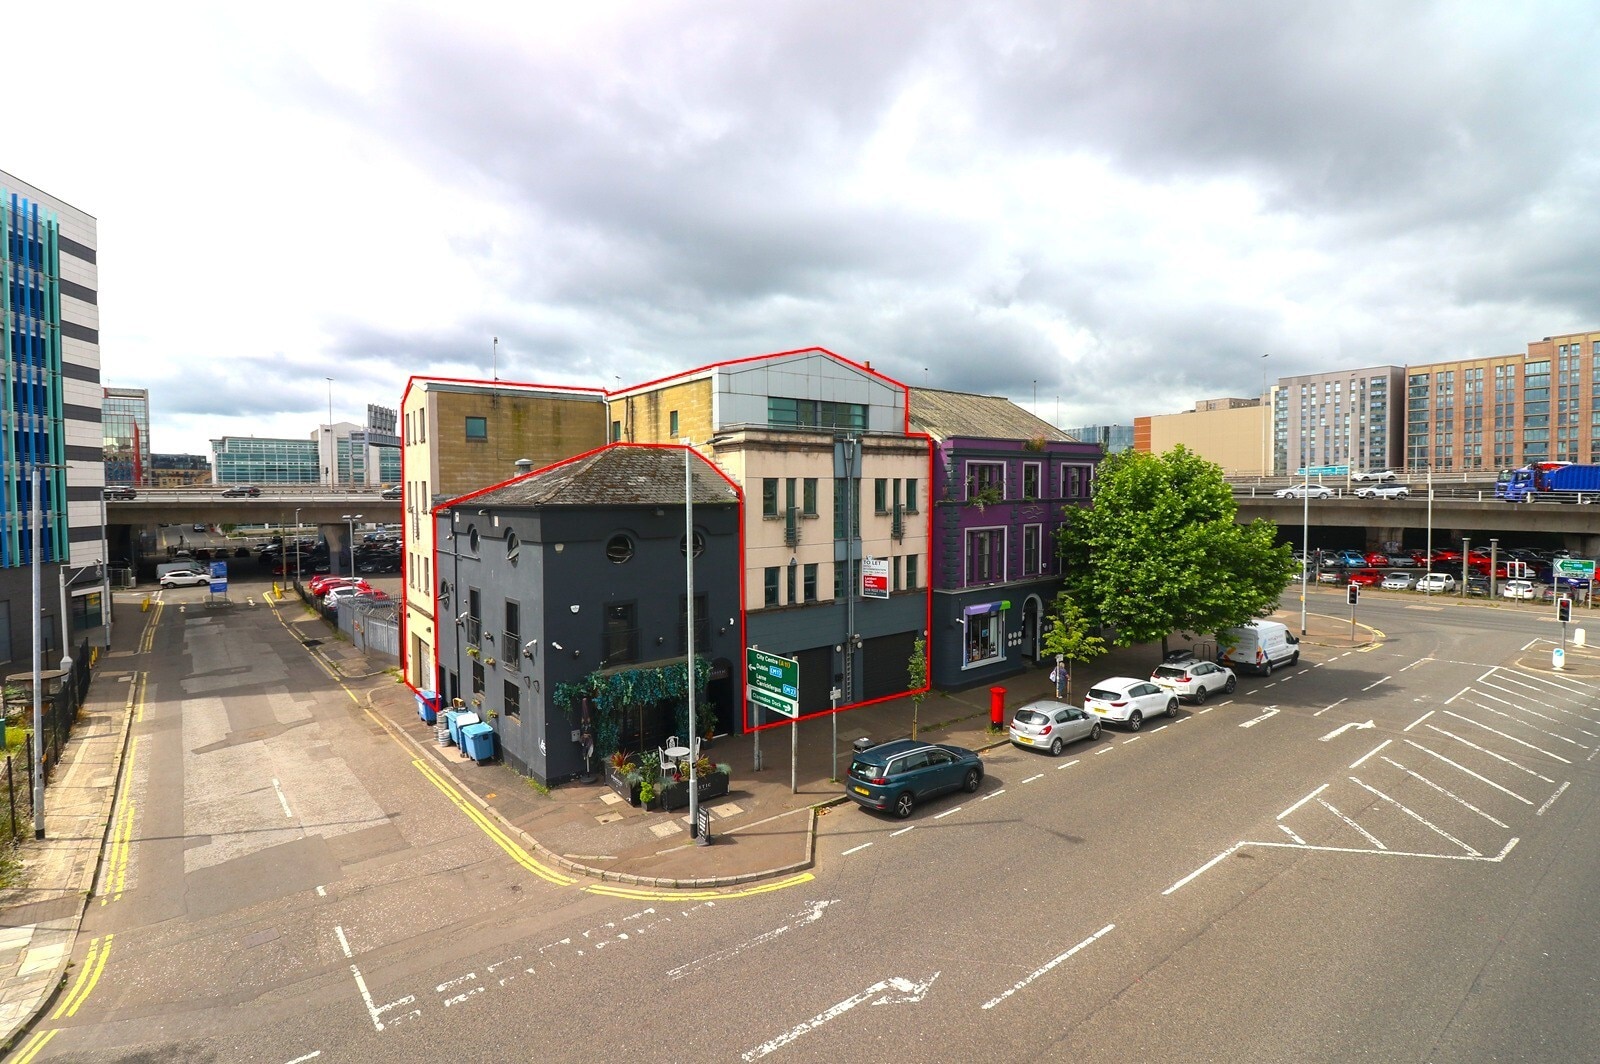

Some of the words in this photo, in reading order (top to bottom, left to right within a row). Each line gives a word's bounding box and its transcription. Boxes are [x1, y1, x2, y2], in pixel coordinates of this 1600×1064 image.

[756, 653, 764, 662] City
[765, 656, 778, 665] Centre
[756, 663, 768, 671] Dublin
[756, 673, 766, 681] Larne
[756, 680, 782, 692] Carrickfergus
[752, 693, 770, 703] Clarendon
